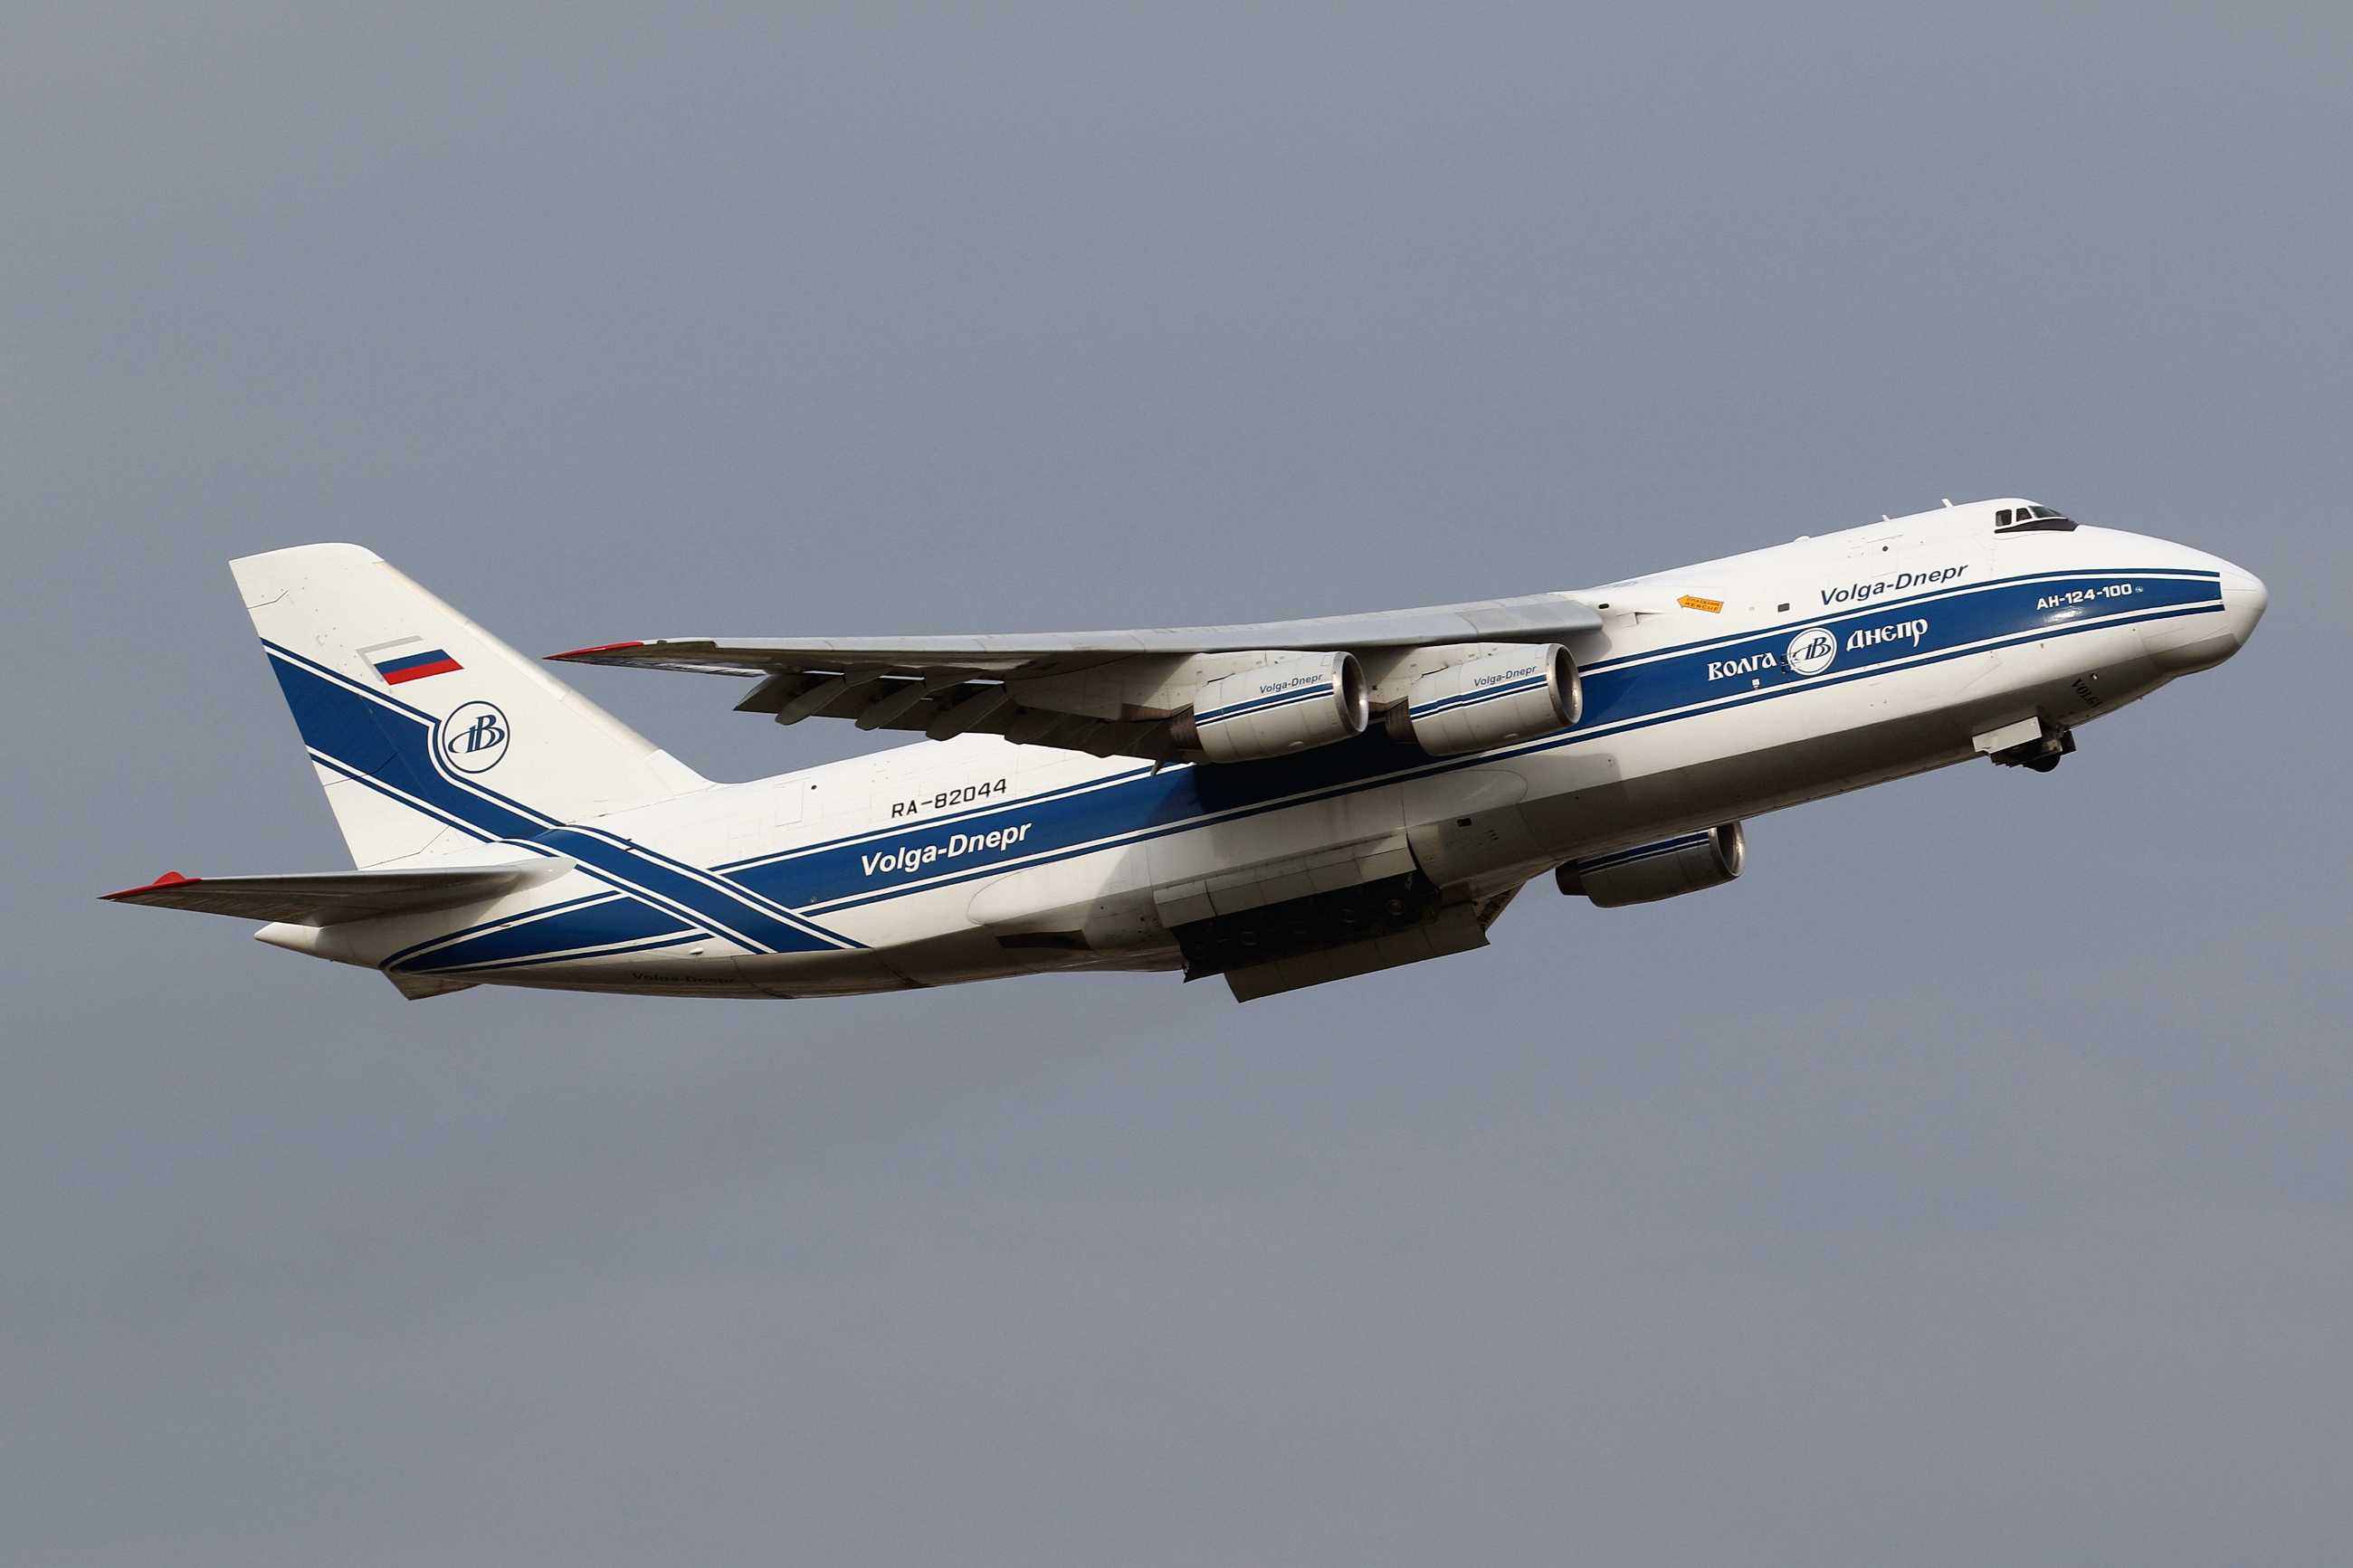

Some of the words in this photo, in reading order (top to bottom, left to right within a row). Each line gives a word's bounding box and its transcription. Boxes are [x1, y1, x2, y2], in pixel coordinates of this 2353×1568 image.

[1820, 564, 1968, 606] Volga-Dnepr
[1259, 673, 1323, 694] Volga-Dnepr
[1473, 665, 1537, 688] Volga-Dnepr
[891, 778, 1007, 818] RA-82044
[862, 822, 1033, 877] Volga-Dnepr
